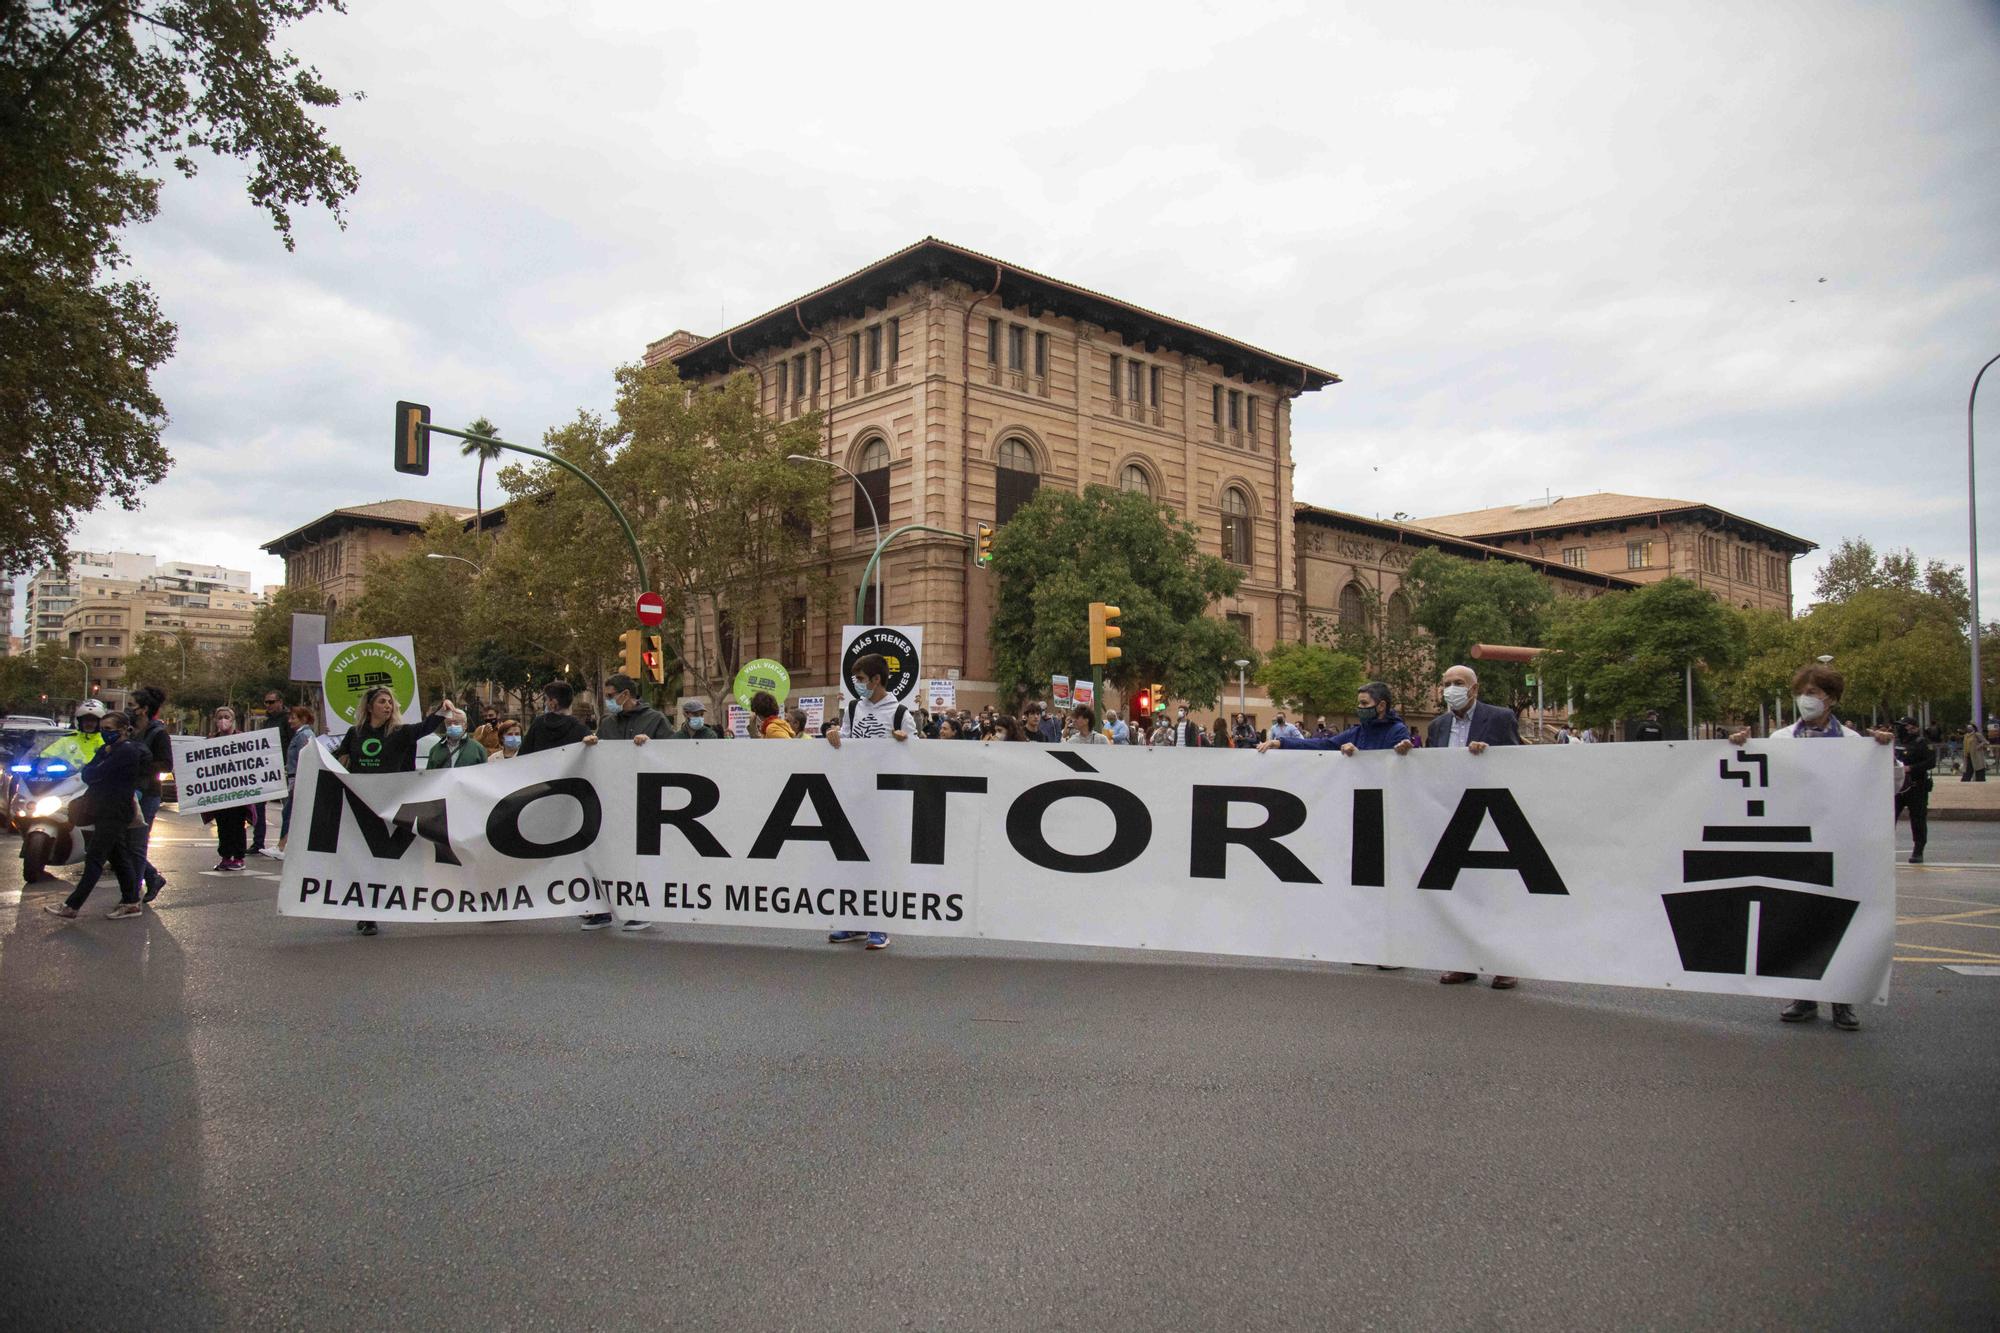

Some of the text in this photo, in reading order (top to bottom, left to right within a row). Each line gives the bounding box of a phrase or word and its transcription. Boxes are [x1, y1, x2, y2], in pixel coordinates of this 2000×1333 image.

[851, 634, 911, 657] MÁS TRENES,
[334, 648, 404, 673] VULL VIATJAR
[744, 664, 760, 674] VULL
[892, 672, 911, 696] CHES
[196, 757, 269, 779] CLIMÀTICA:
[186, 769, 281, 796] SOLUCIONS JA!
[197, 787, 263, 806] GREENPEACE
[307, 750, 1569, 895] MORATÒRIA
[300, 876, 964, 922] PLATAFORMA CONTRA ELS MEGACREUERS
